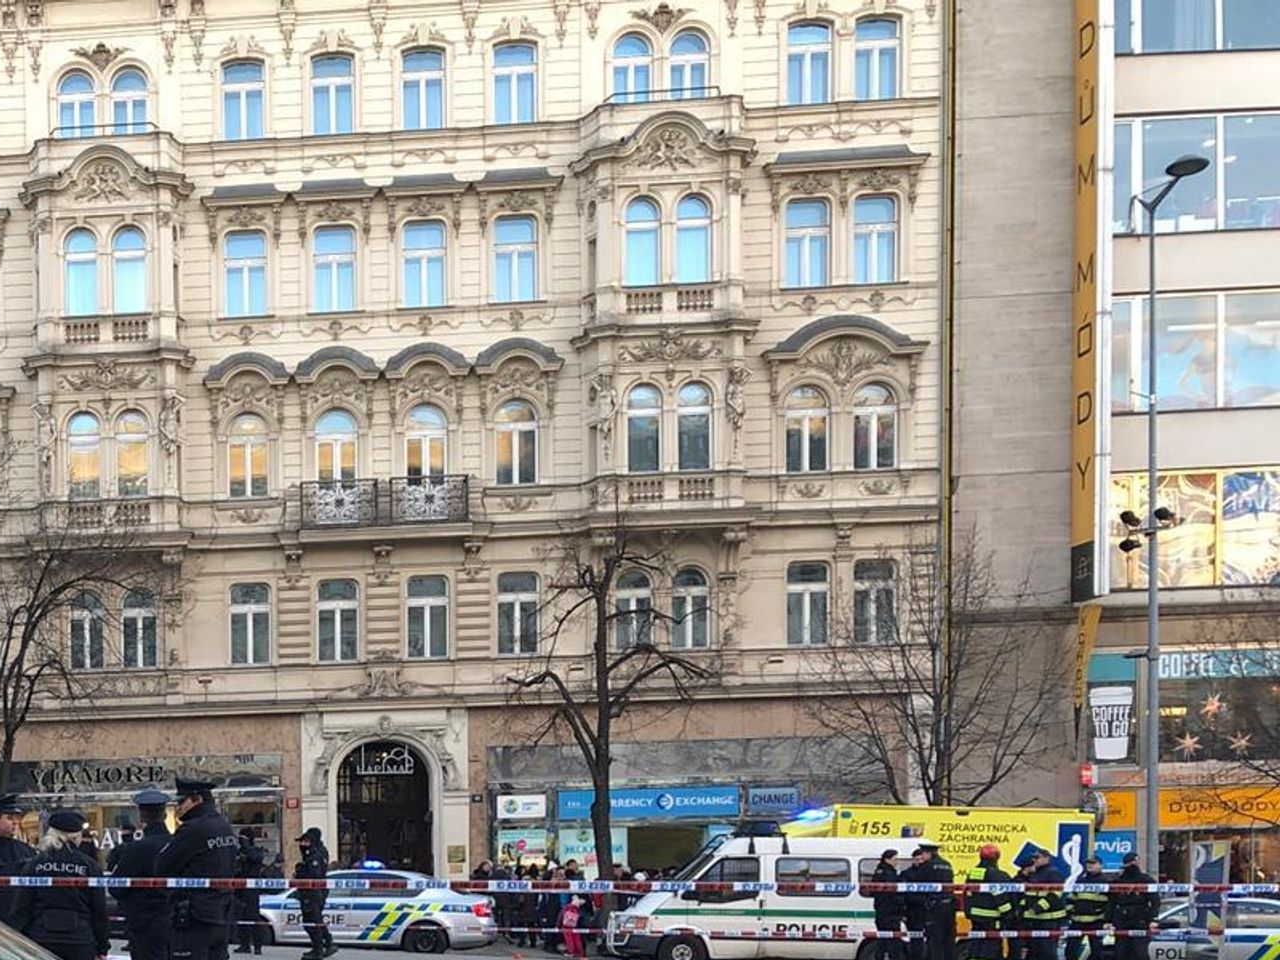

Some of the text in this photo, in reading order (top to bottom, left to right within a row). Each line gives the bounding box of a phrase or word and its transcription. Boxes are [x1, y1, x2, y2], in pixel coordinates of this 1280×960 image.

[1092, 705, 1130, 722] COFFEE
[1095, 722, 1110, 737] TO
[30, 766, 163, 785] VIAMORE
[675, 794, 734, 807] EXCHANGE
[751, 792, 796, 805] CHANGE
[860, 821, 891, 835] 155
[35, 862, 88, 877] POLICIE
[287, 913, 345, 925] POCIE
